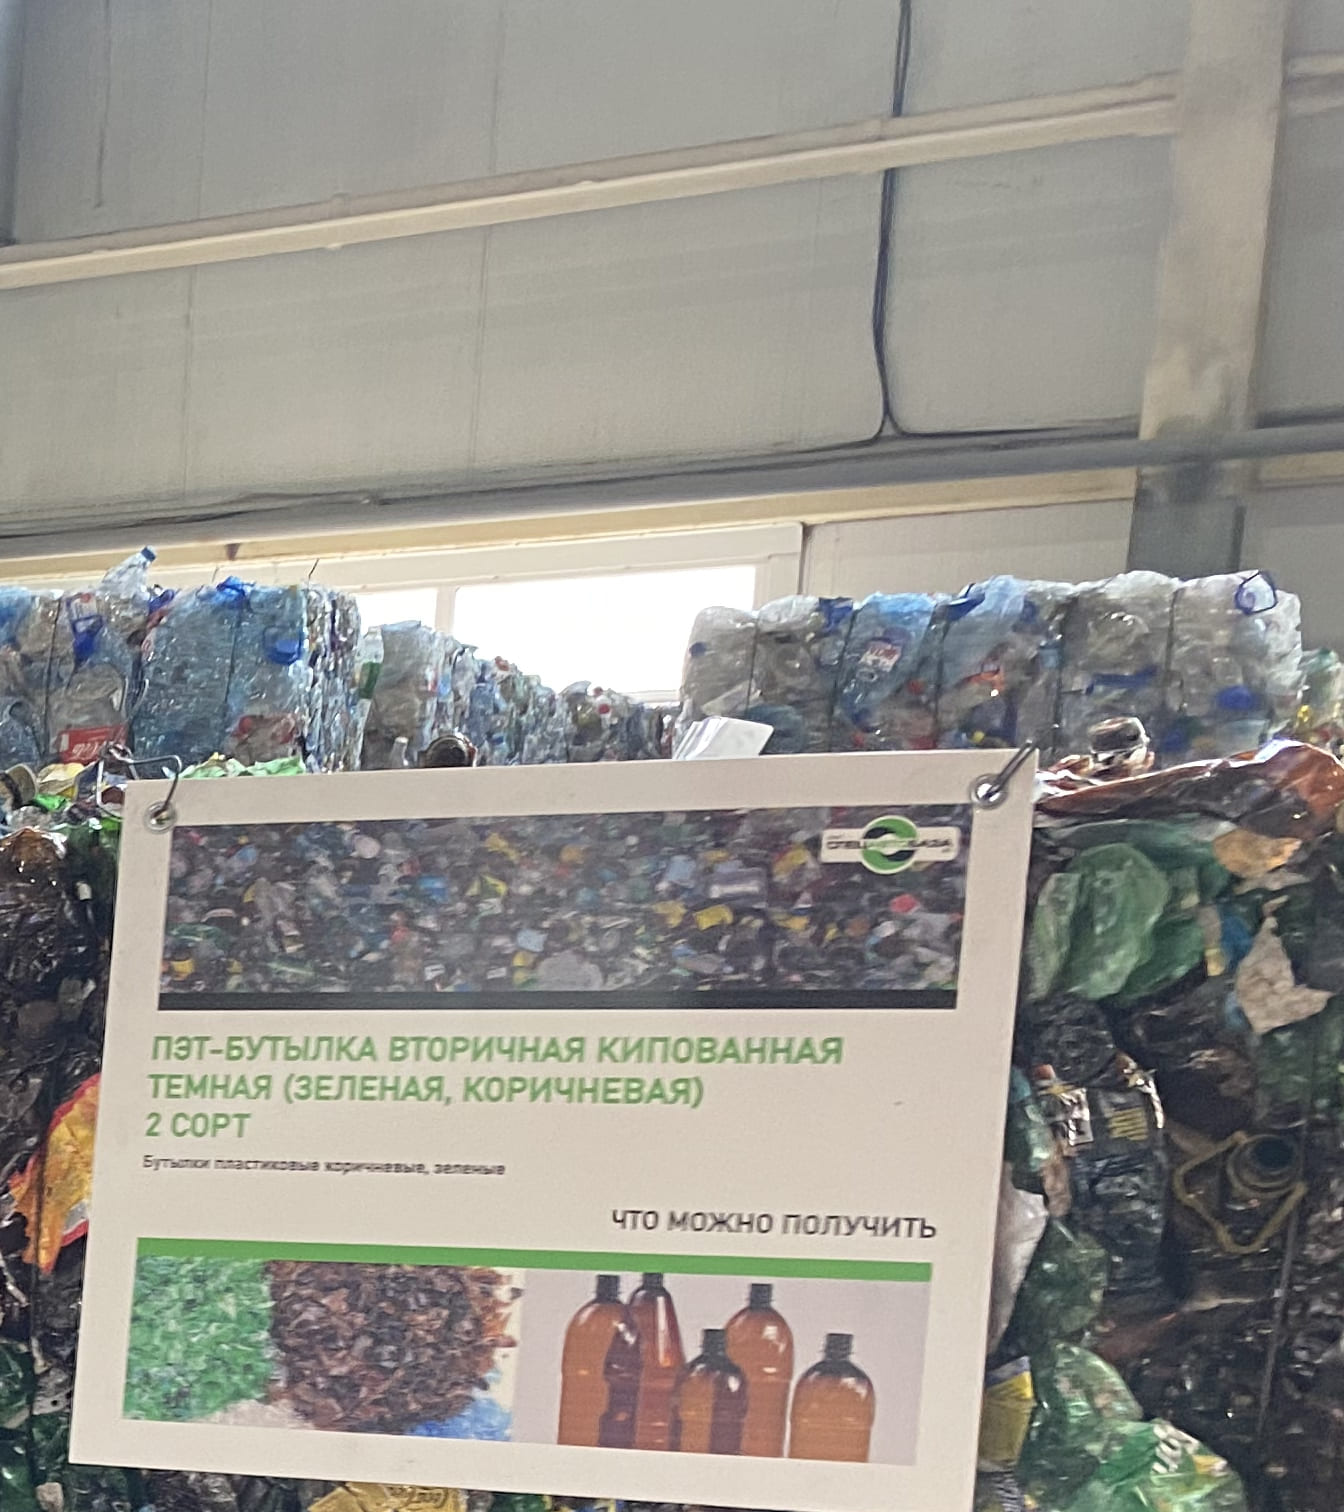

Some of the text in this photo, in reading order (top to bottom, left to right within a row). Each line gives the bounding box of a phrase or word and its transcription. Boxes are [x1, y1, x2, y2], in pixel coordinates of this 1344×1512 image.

[151, 1035, 844, 1065] ПЭТ-БУТЫЛКА ВТОРИЧНАЯ КИПОВАННАЯ
[148, 1073, 704, 1109] ТЕМНАЯ (ЗЕЛЕНАЯ, КОРИЧНЕВАЯ)
[144, 1113, 251, 1139] 2 СОРТ
[143, 1155, 210, 1171] Бутылки
[214, 1157, 320, 1172] пластиковые
[433, 1163, 506, 1176] зеленые
[612, 1209, 937, 1239] ЧТО МОЖНО ПОЛУЧИТЬ
